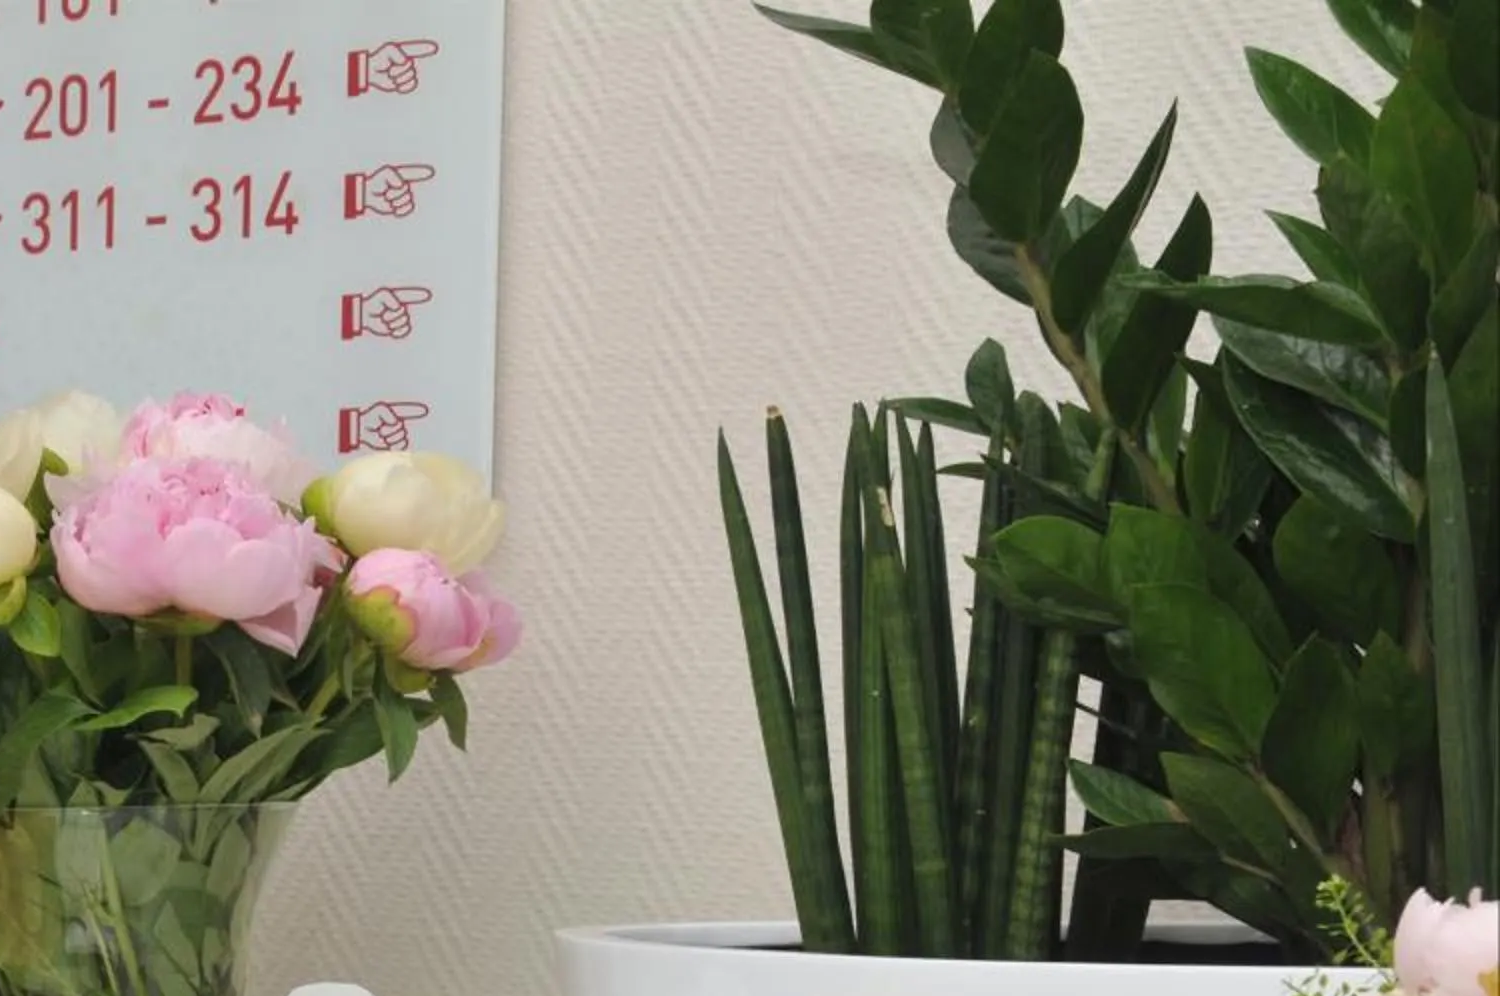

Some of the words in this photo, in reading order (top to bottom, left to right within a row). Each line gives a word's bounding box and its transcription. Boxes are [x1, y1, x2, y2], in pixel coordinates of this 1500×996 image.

[23, 66, 119, 143] 201
[146, 97, 170, 110] -
[190, 50, 304, 127] 234
[20, 183, 117, 257] 311
[146, 215, 167, 226] -
[189, 169, 301, 244] 314
